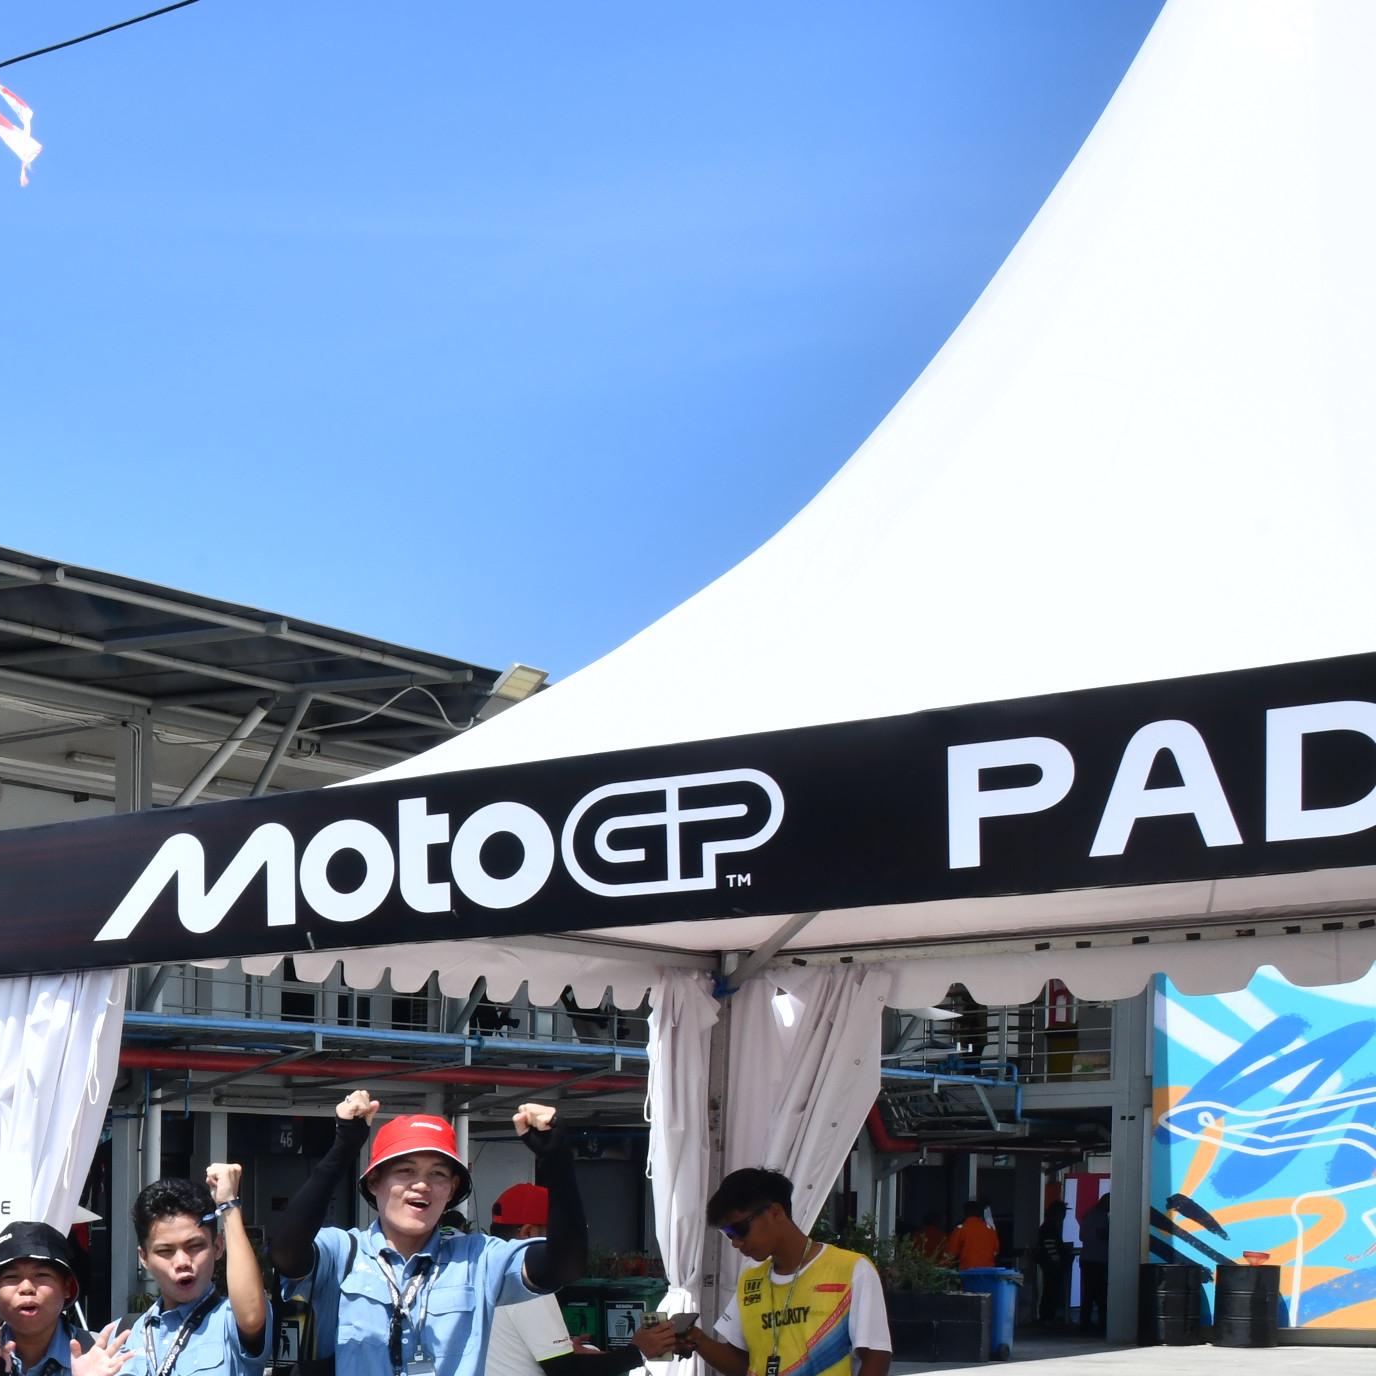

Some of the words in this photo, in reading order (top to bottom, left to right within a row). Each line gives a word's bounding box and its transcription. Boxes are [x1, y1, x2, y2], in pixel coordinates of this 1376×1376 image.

[947, 700, 1376, 870] PAD
[280, 1132, 293, 1148] 46
[761, 1306, 811, 1330] SECURITY
